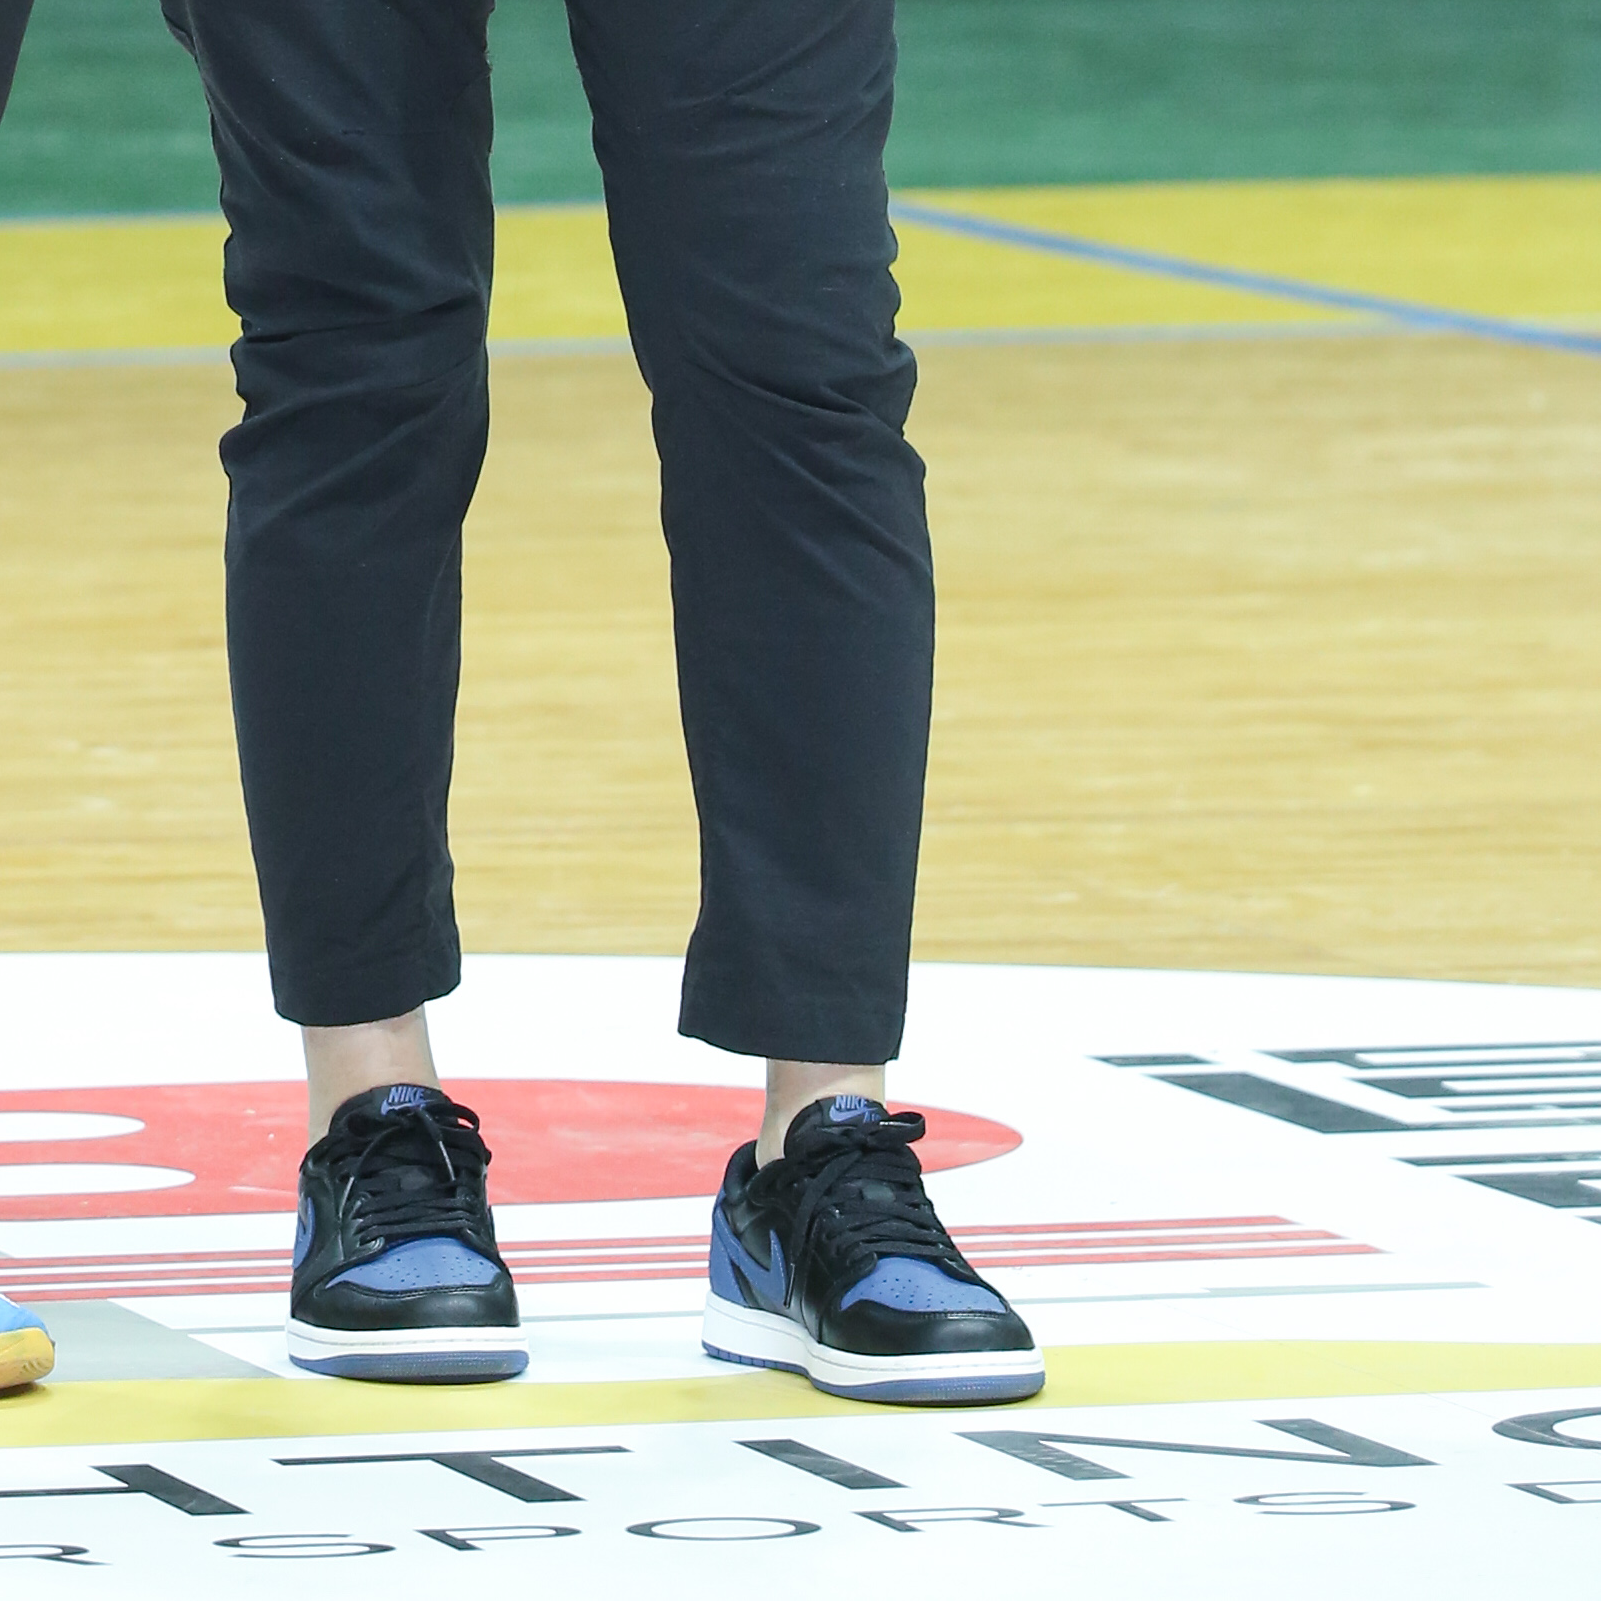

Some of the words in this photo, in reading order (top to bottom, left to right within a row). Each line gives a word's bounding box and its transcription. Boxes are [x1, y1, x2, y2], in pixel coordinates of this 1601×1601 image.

[388, 1085, 426, 1104] NIKE
[834, 1093, 870, 1110] NIKE
[212, 1487, 1417, 1560] SPORTS
